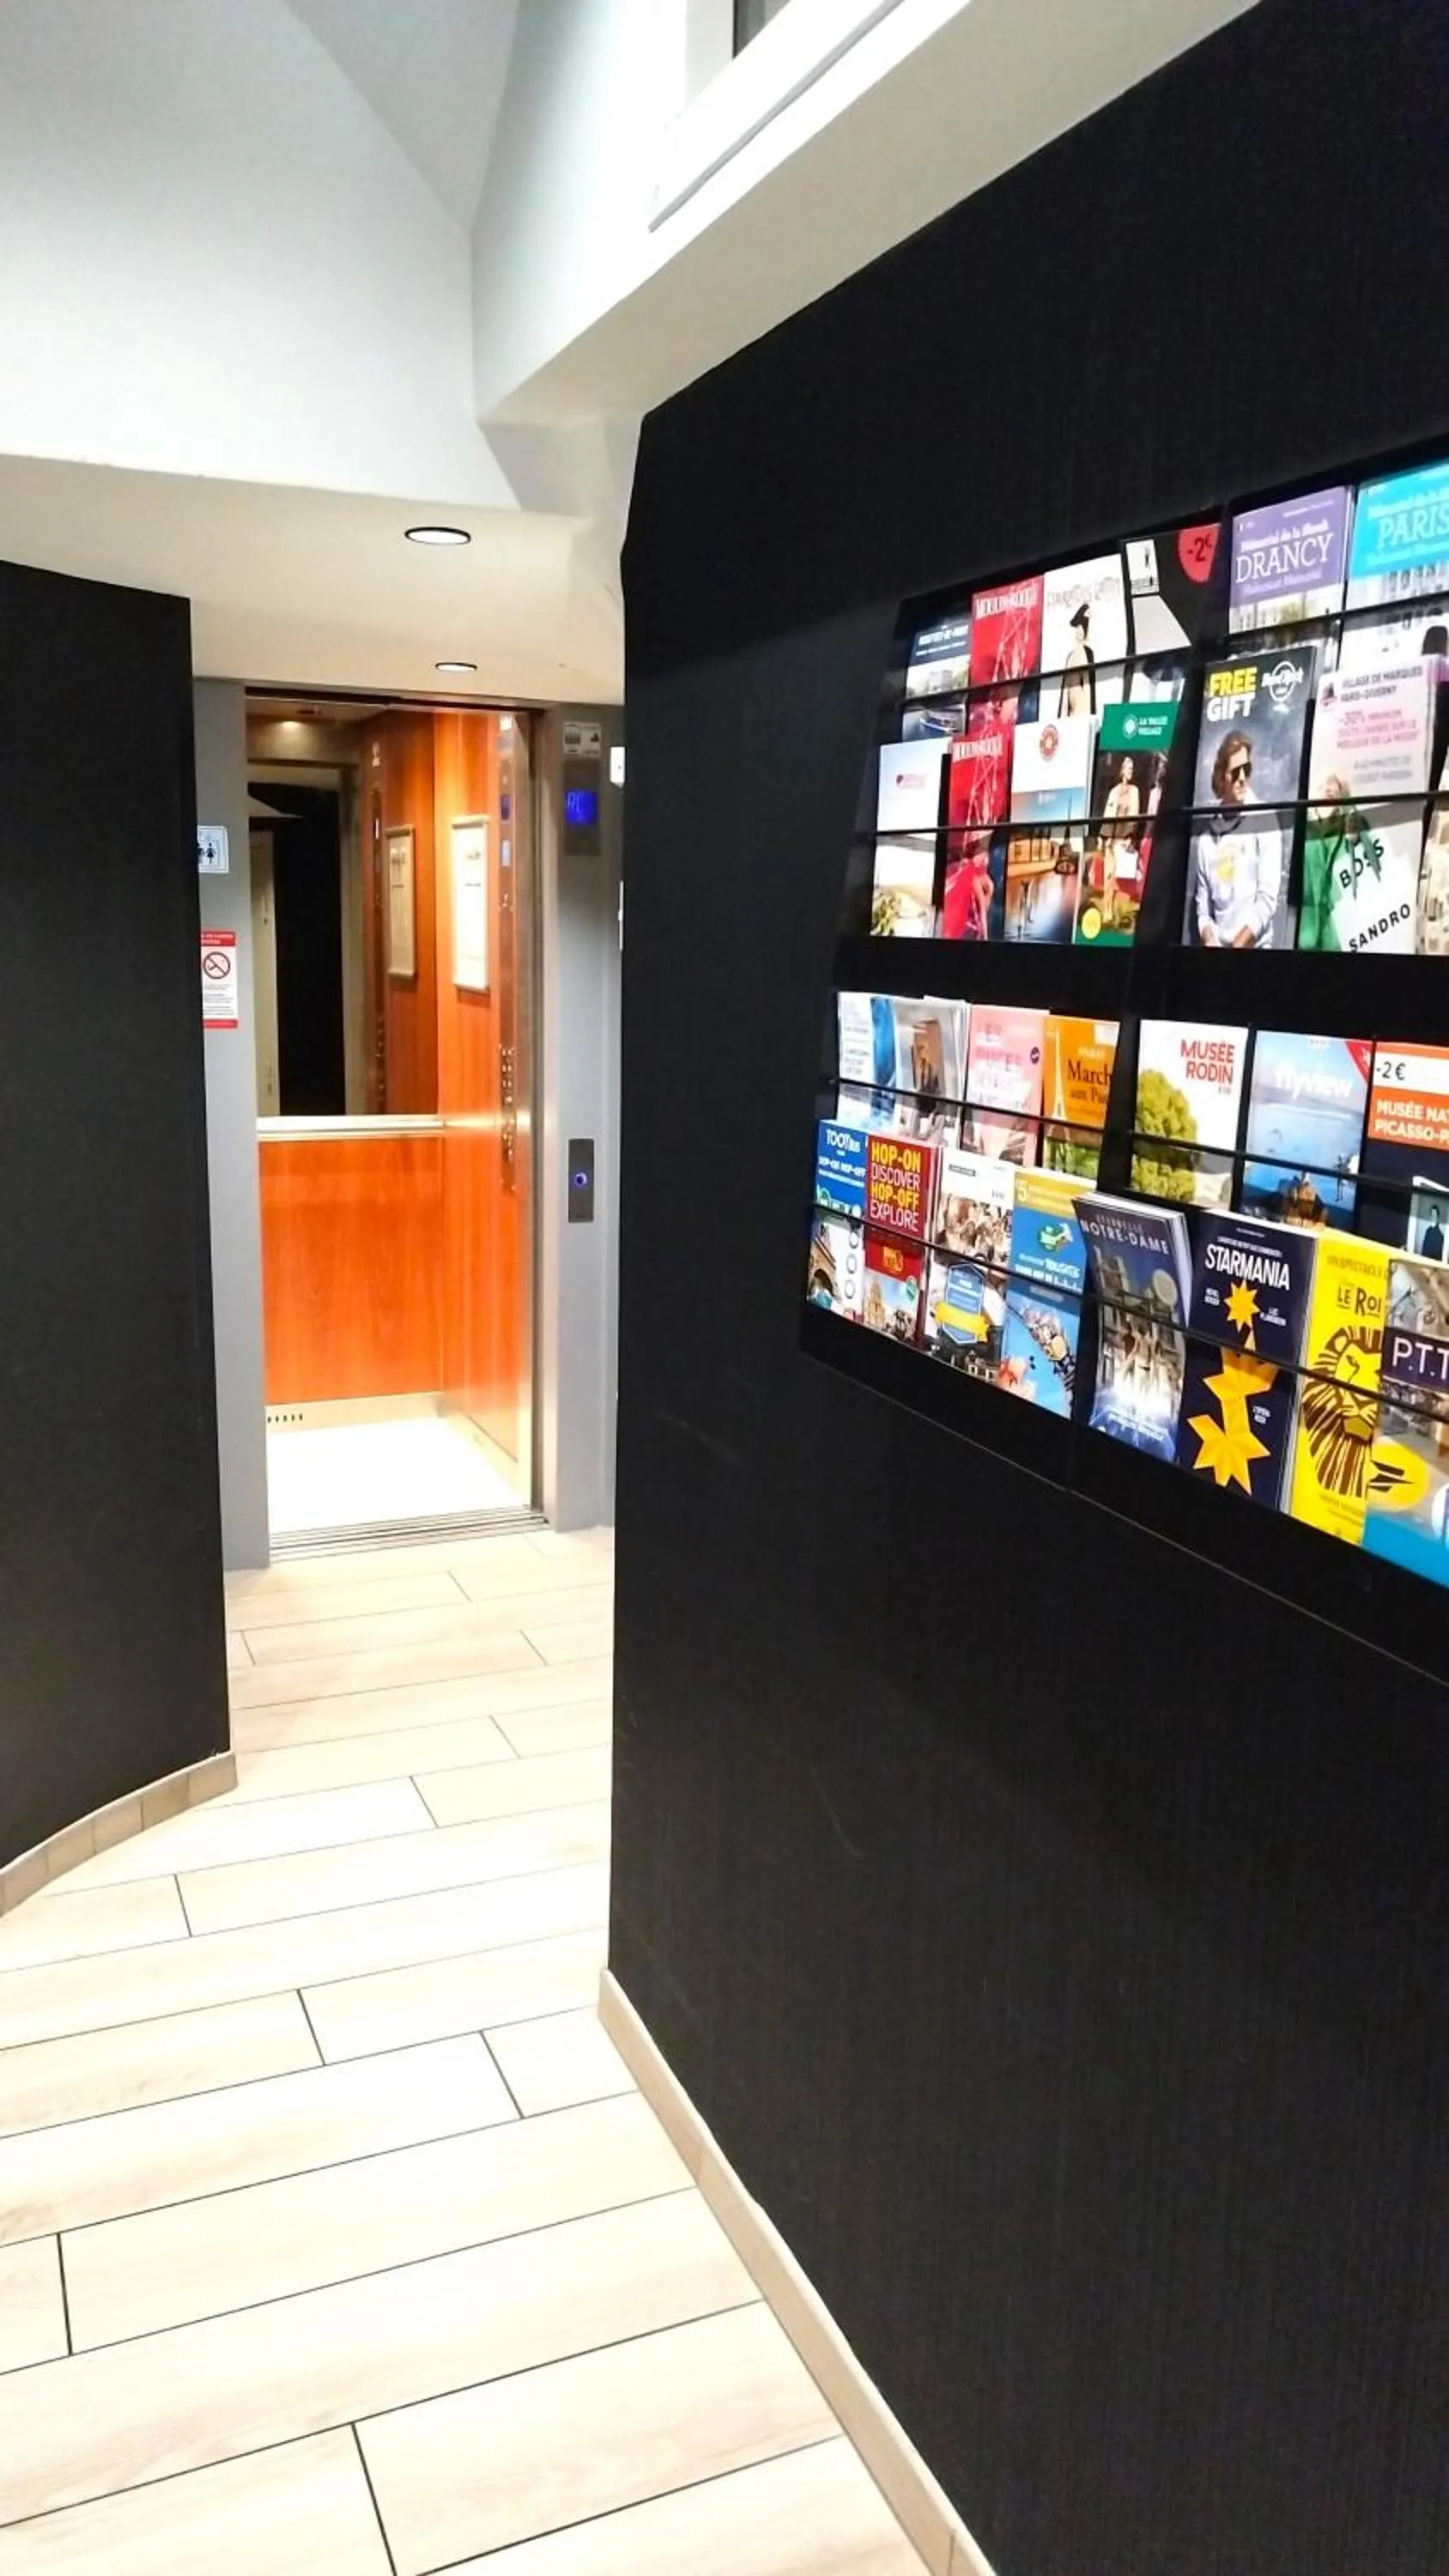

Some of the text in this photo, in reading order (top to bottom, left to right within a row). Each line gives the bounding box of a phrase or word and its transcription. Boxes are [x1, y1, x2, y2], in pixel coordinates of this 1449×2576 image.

[1236, 532, 1335, 584] DRANCY
[1208, 666, 1258, 698] FREE
[1206, 692, 1256, 722] GIFT
[1349, 903, 1411, 953] SANDRO
[1181, 1038, 1235, 1064] MUSÉE
[1186, 1061, 1234, 1086] RODIN
[1376, 1099, 1425, 1120] MUSÉE
[1374, 1119, 1449, 1145] PICASSO-P
[871, 1140, 922, 1174] HOP-ON
[871, 1162, 921, 1192] DISCOVER
[871, 1181, 920, 1212] HOP-OFF
[870, 1199, 920, 1229] EXPLORE
[1080, 1218, 1169, 1255] NOTRE-DAME
[1204, 1242, 1290, 1291] STARMANIA
